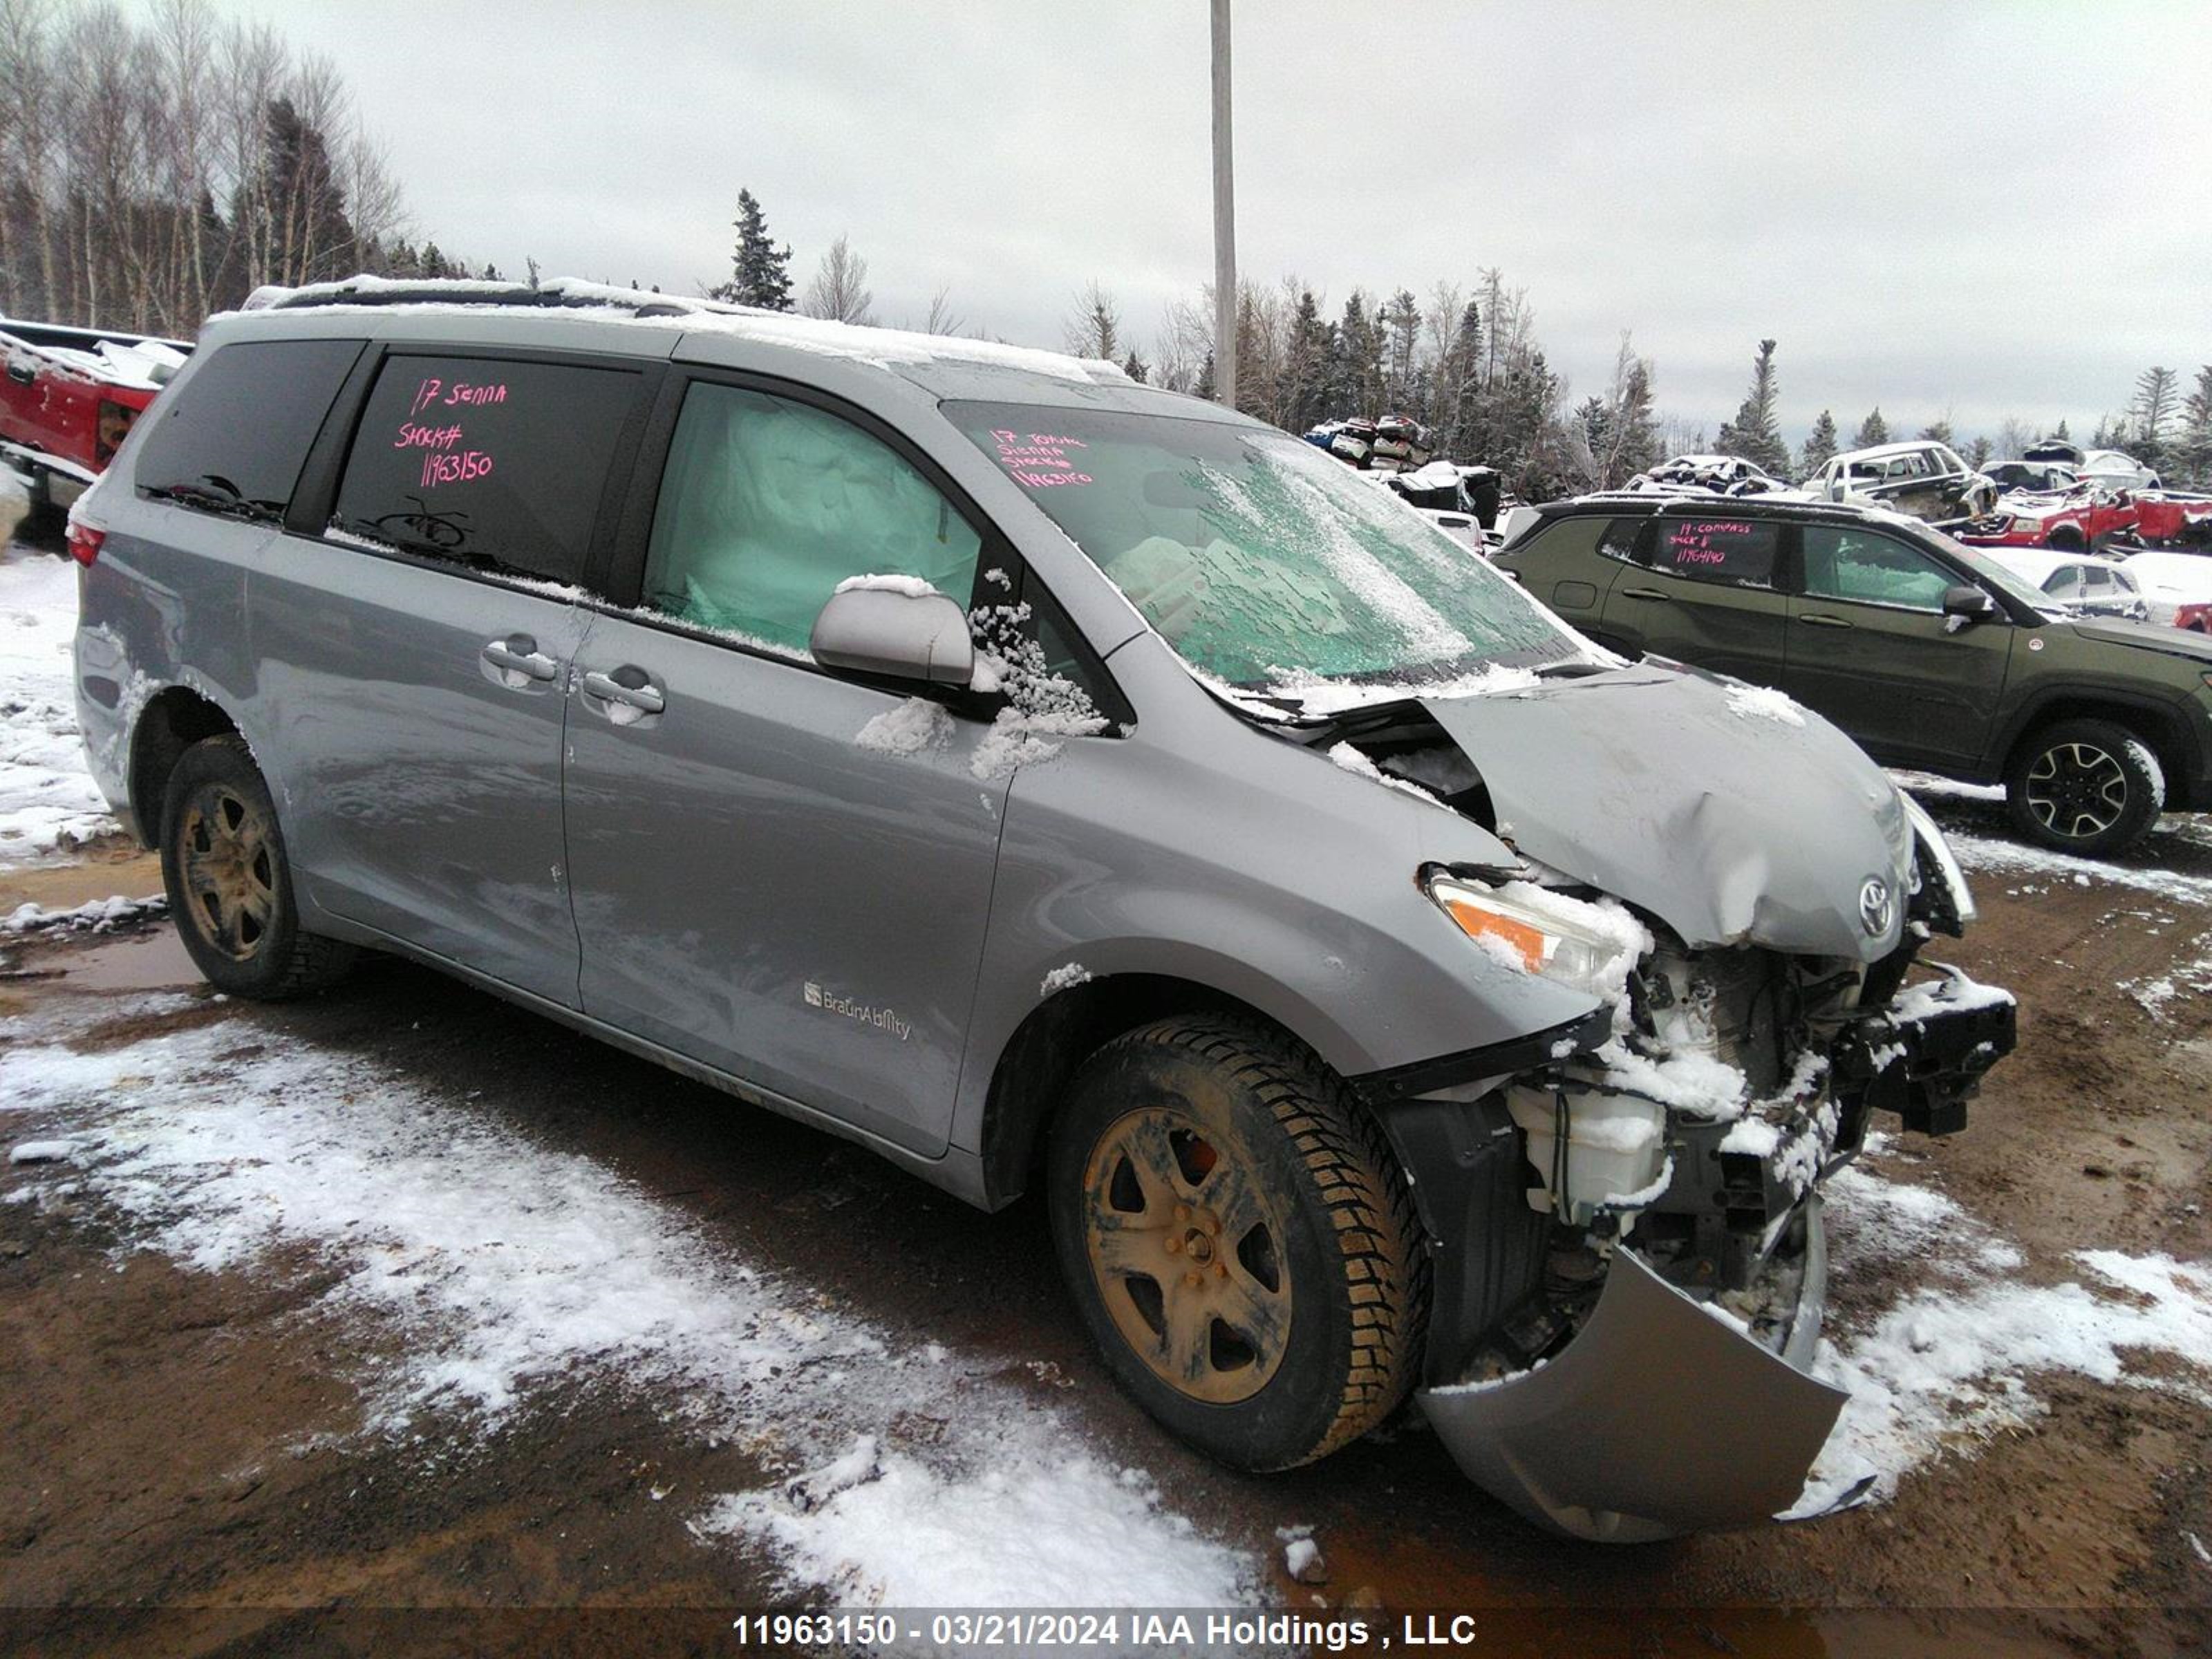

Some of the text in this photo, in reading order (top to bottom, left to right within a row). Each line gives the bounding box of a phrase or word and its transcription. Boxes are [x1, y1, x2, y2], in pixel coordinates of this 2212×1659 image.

[411, 379, 441, 416] 17
[989, 430, 1017, 443] 17
[421, 451, 492, 487] 11963150
[823, 991, 911, 1040] BraunAbility
